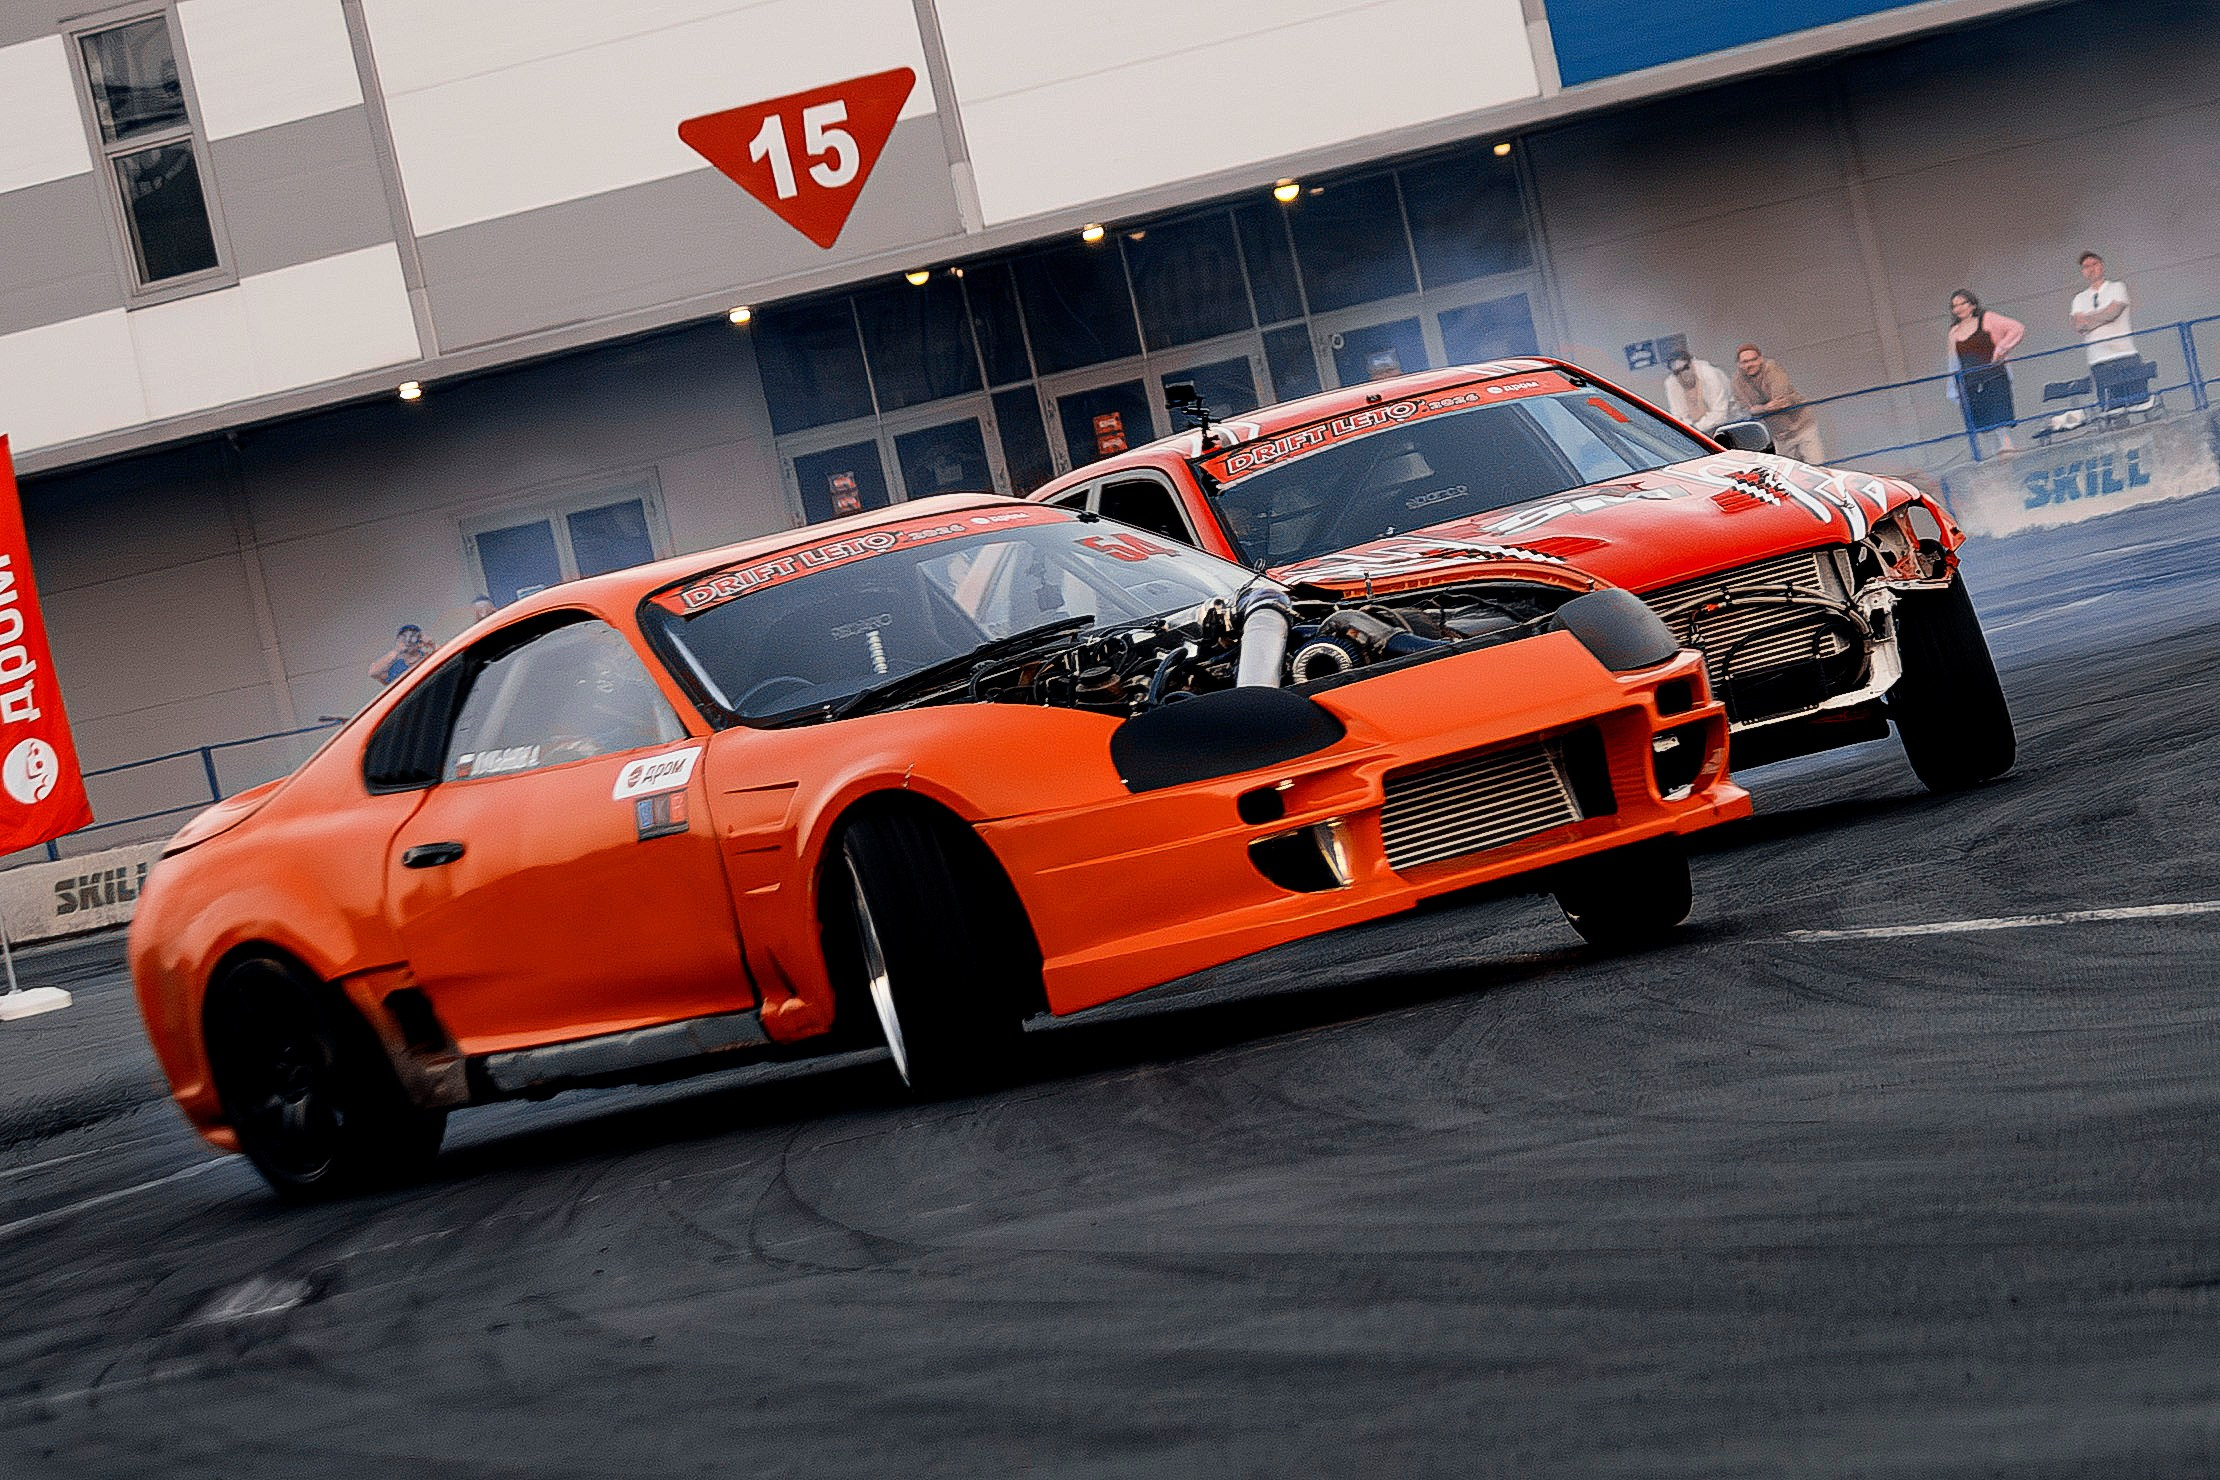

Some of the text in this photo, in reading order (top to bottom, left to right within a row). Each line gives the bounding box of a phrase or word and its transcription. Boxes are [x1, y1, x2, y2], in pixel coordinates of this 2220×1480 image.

[749, 99, 860, 200] 15
[1226, 426, 1325, 475] DRIFT
[1331, 401, 1418, 438] LETO
[1587, 397, 1629, 423] 1
[2023, 448, 2151, 510] SKILL
[681, 557, 796, 609] DRIFT
[800, 532, 897, 568] LETO
